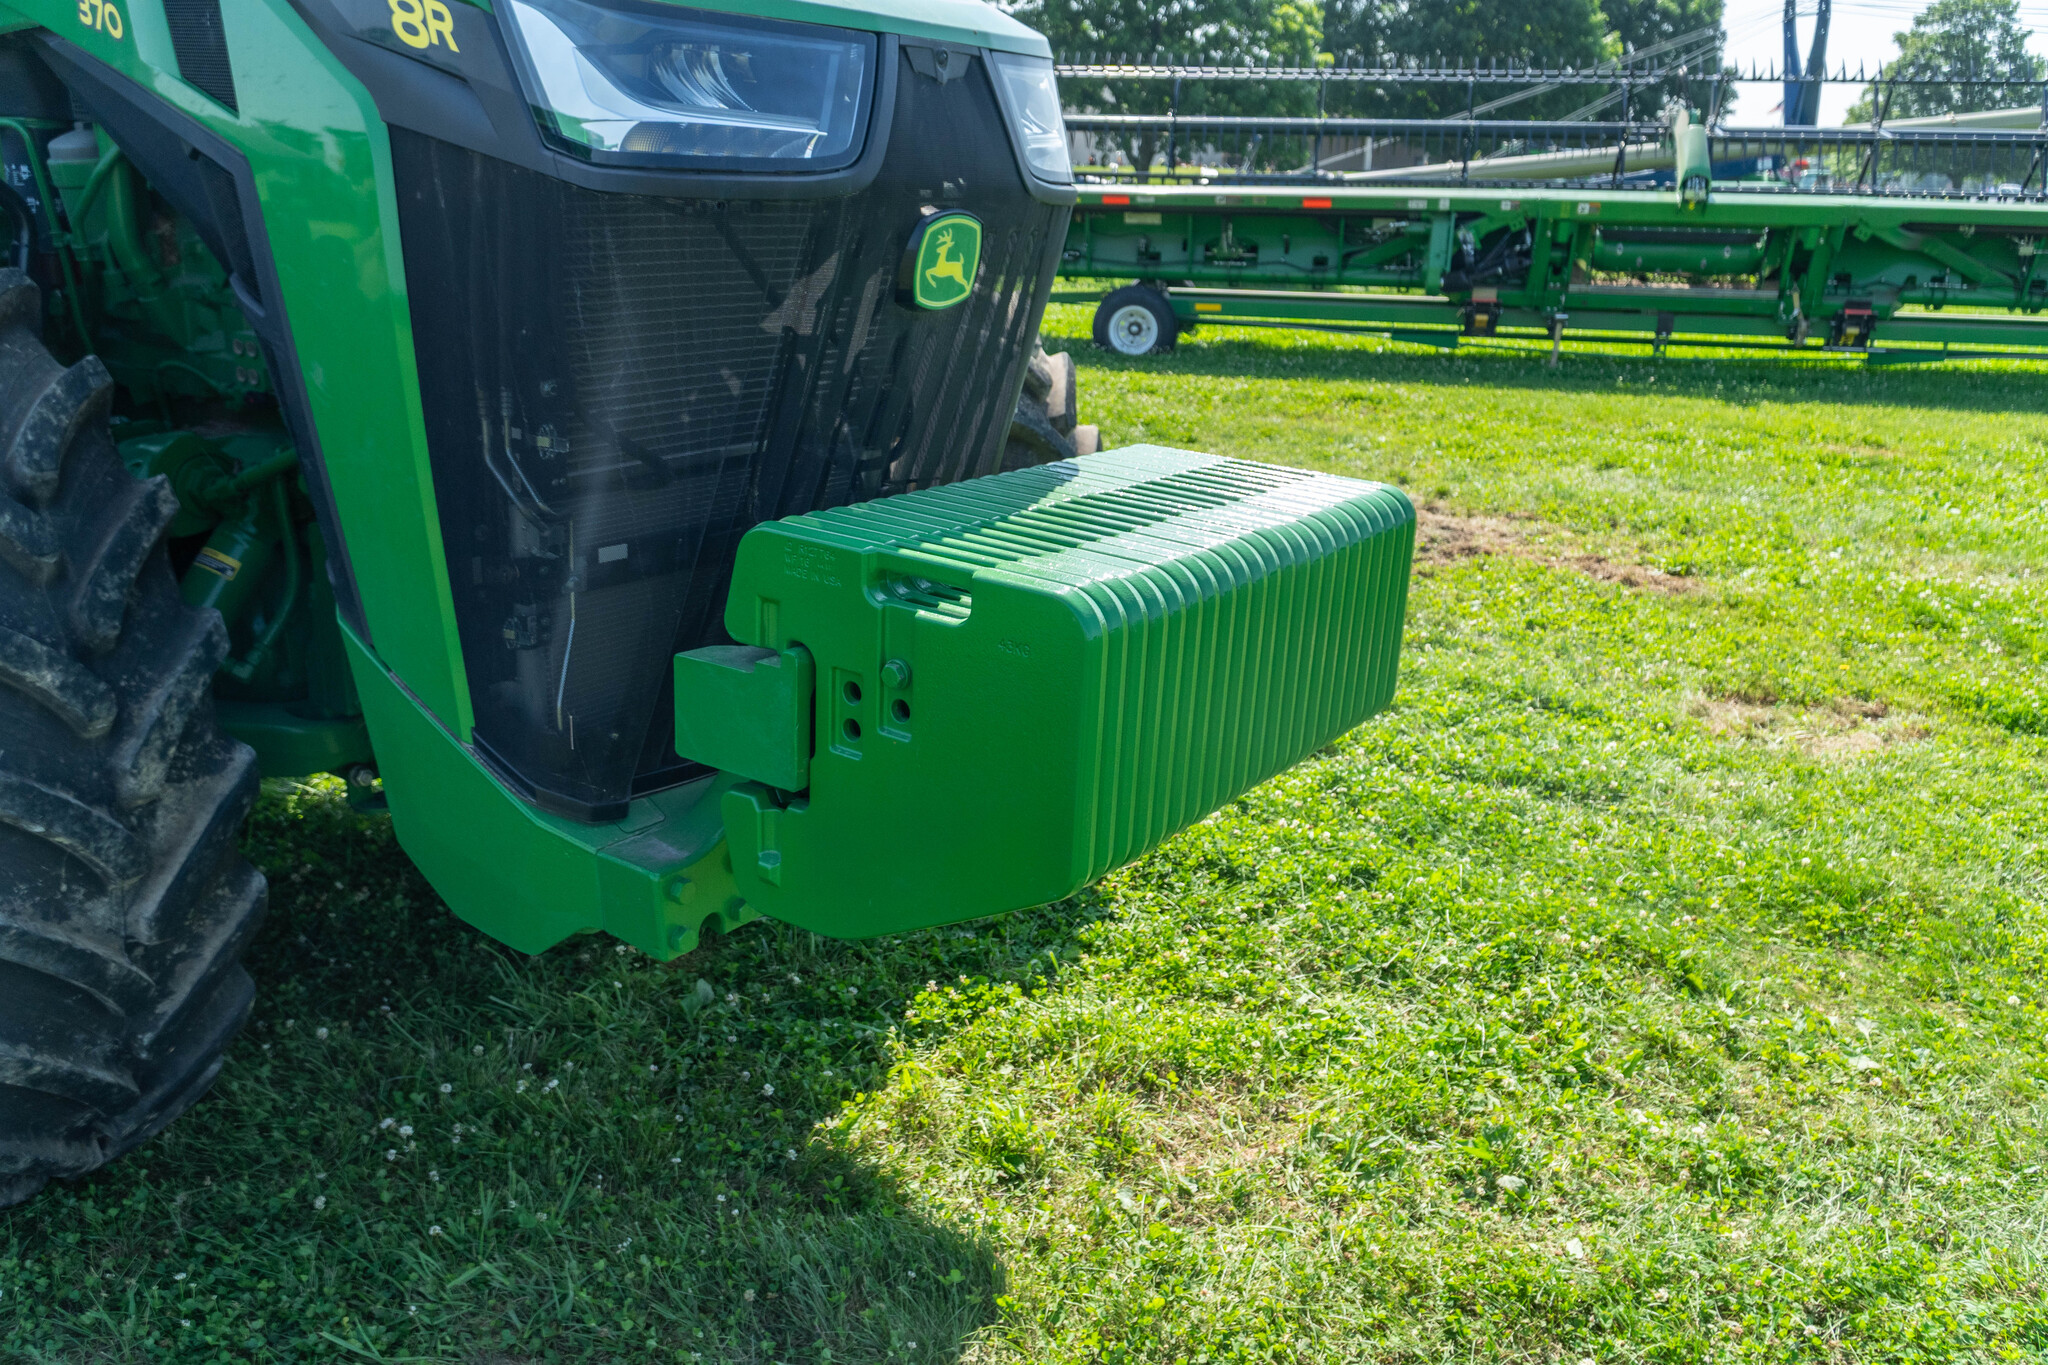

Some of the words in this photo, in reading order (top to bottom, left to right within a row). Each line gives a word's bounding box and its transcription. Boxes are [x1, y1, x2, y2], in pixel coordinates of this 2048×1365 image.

[79, 0, 122, 40] 370
[387, 0, 460, 53] 8R
[783, 565, 808, 580] MADE
[823, 574, 842, 587] USA
